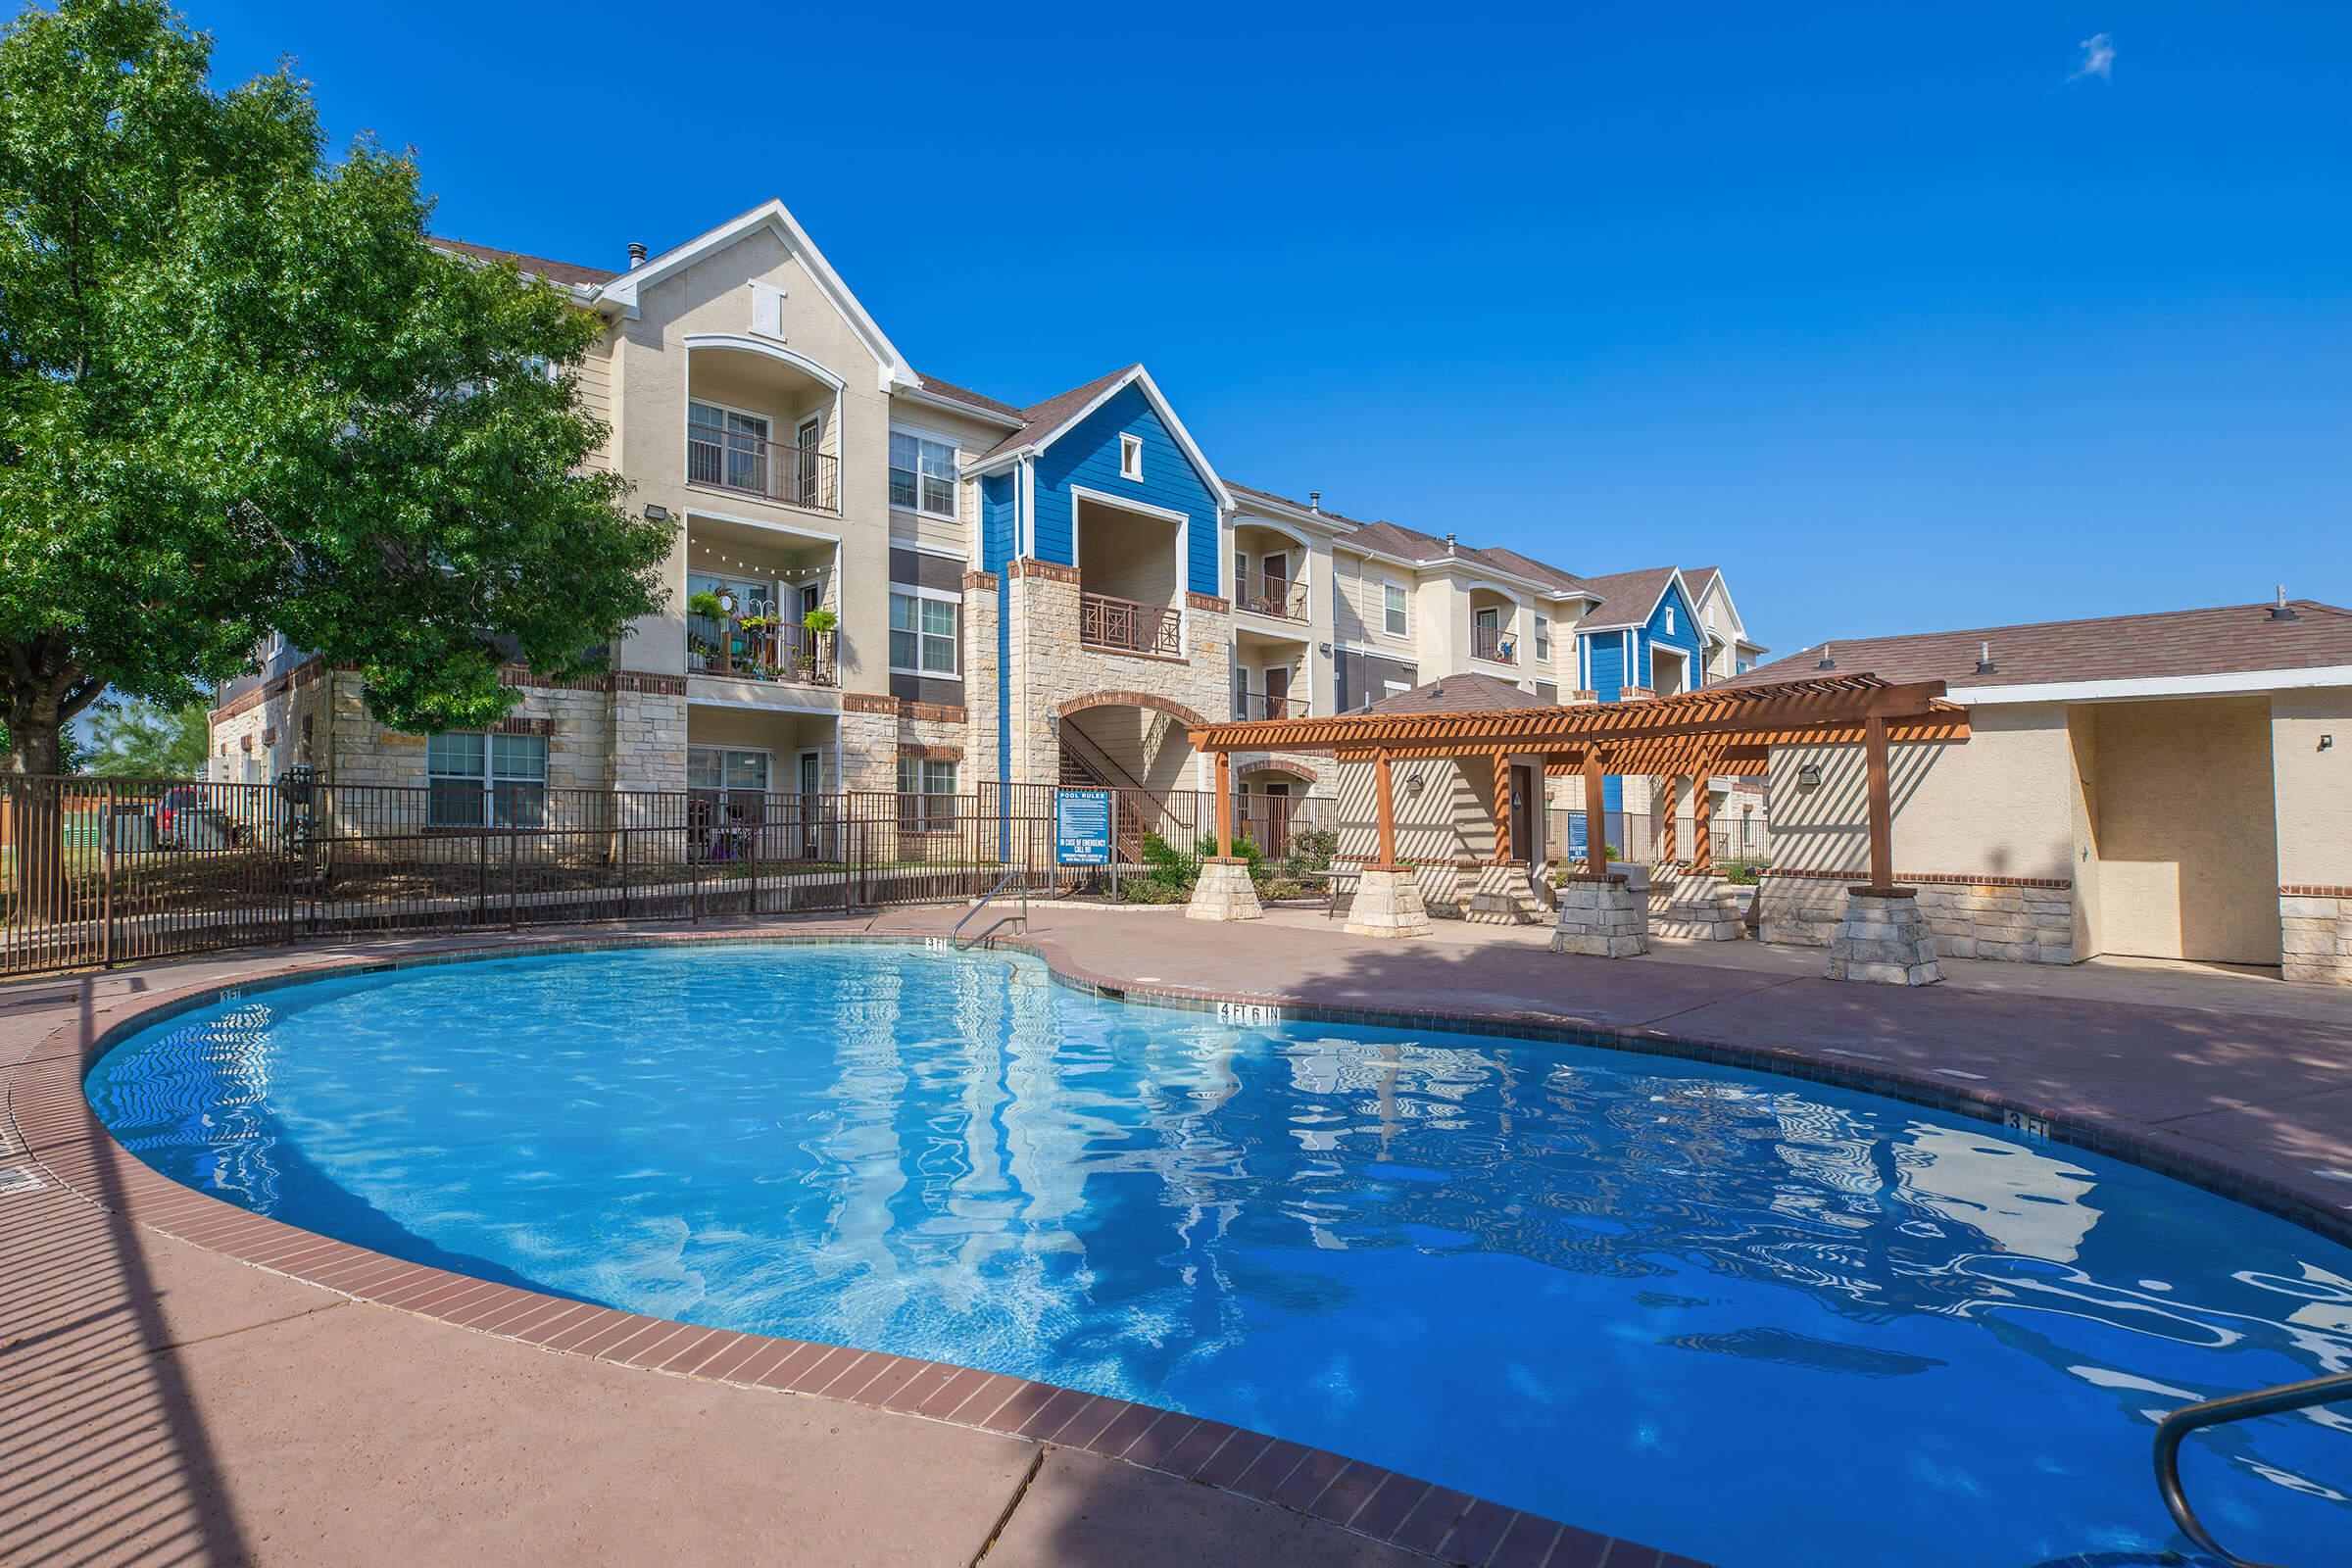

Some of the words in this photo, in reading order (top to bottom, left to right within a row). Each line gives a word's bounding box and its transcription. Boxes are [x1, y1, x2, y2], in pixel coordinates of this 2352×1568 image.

[222, 991, 227, 1001] 3
[1221, 1004, 1229, 1015] 4
[1234, 1004, 1247, 1018] FT
[1252, 1007, 1259, 1019] 6
[1266, 1006, 1277, 1019] IN
[2010, 1112, 2020, 1129] 3
[2028, 1117, 2046, 1137] FT
